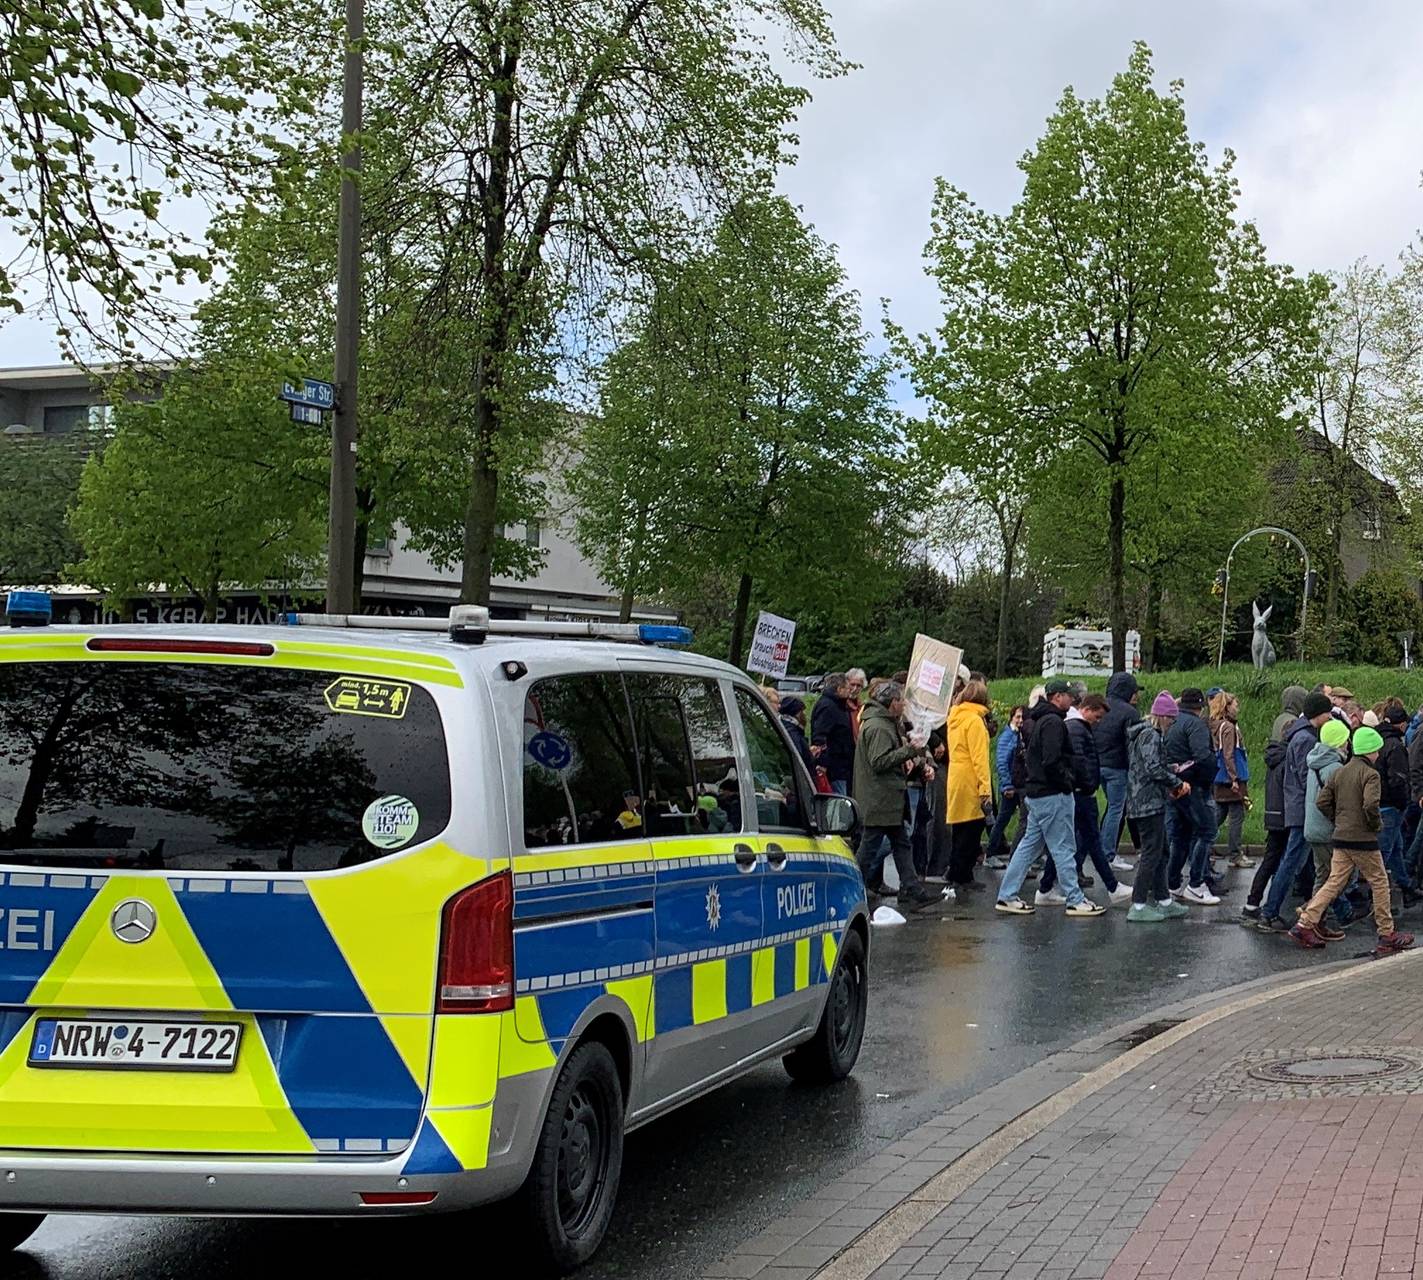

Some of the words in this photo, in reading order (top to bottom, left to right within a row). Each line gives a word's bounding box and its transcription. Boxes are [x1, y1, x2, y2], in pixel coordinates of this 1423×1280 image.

[379, 815, 413, 825] TEAM
[777, 881, 816, 919] POLIZEI
[38, 1044, 47, 1054] D
[52, 1025, 113, 1057] NRW
[127, 1026, 237, 1060] 4-7122
